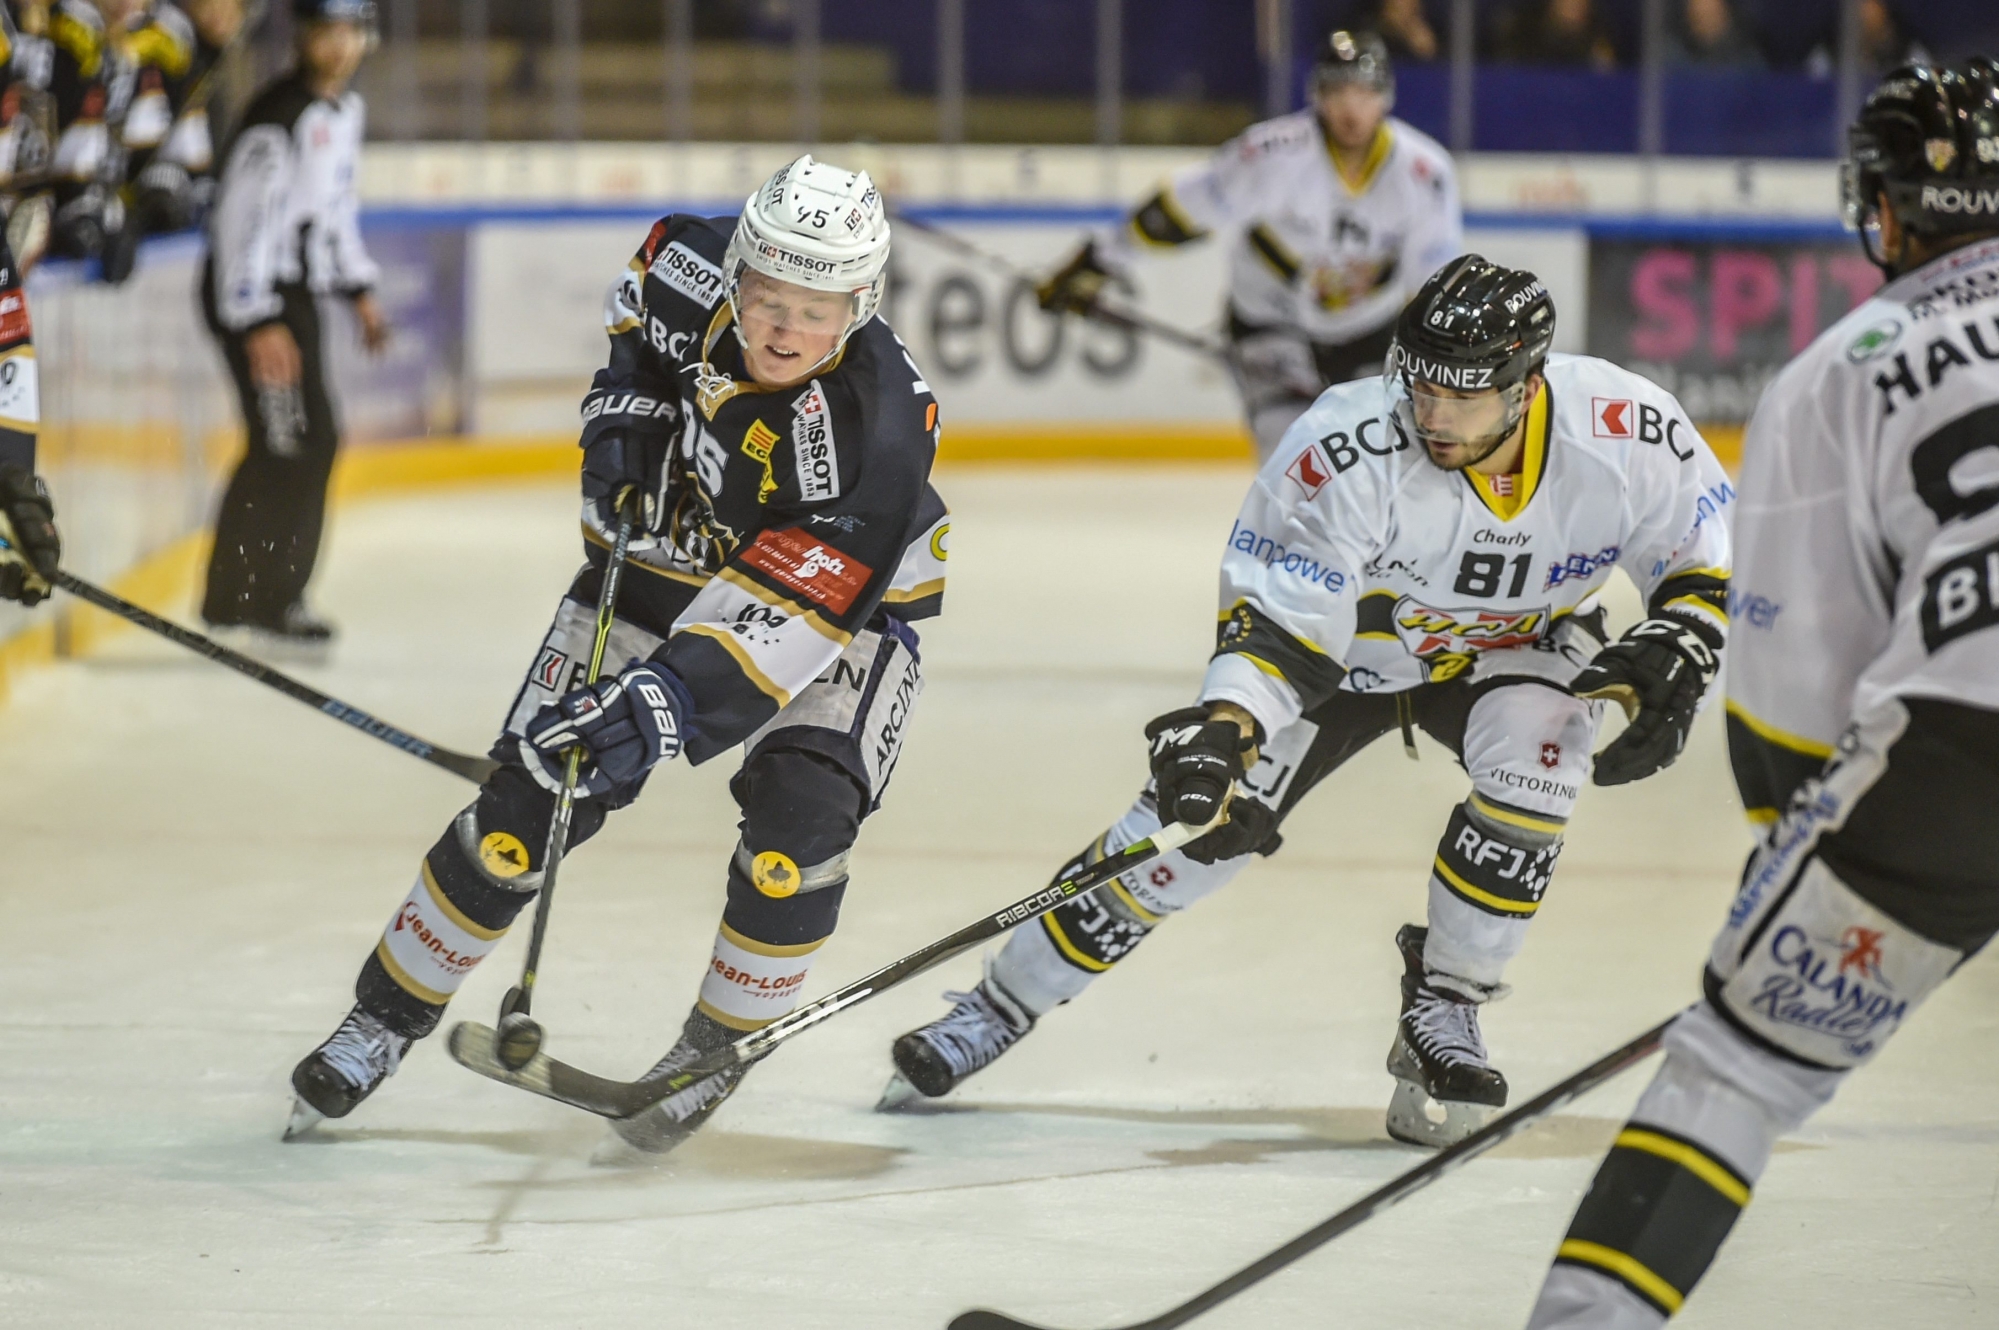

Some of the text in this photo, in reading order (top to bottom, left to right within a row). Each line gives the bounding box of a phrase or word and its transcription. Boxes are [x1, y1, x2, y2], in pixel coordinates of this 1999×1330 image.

[662, 247, 722, 292] TISSOT
[778, 249, 837, 274] TISSOT
[1430, 310, 1455, 329] 81
[1394, 345, 1494, 389] OUVINEZ
[807, 414, 832, 495] TISSOT
[1473, 529, 1533, 547] Charly
[1453, 551, 1533, 598] 81
[1454, 825, 1527, 879] RFJ
